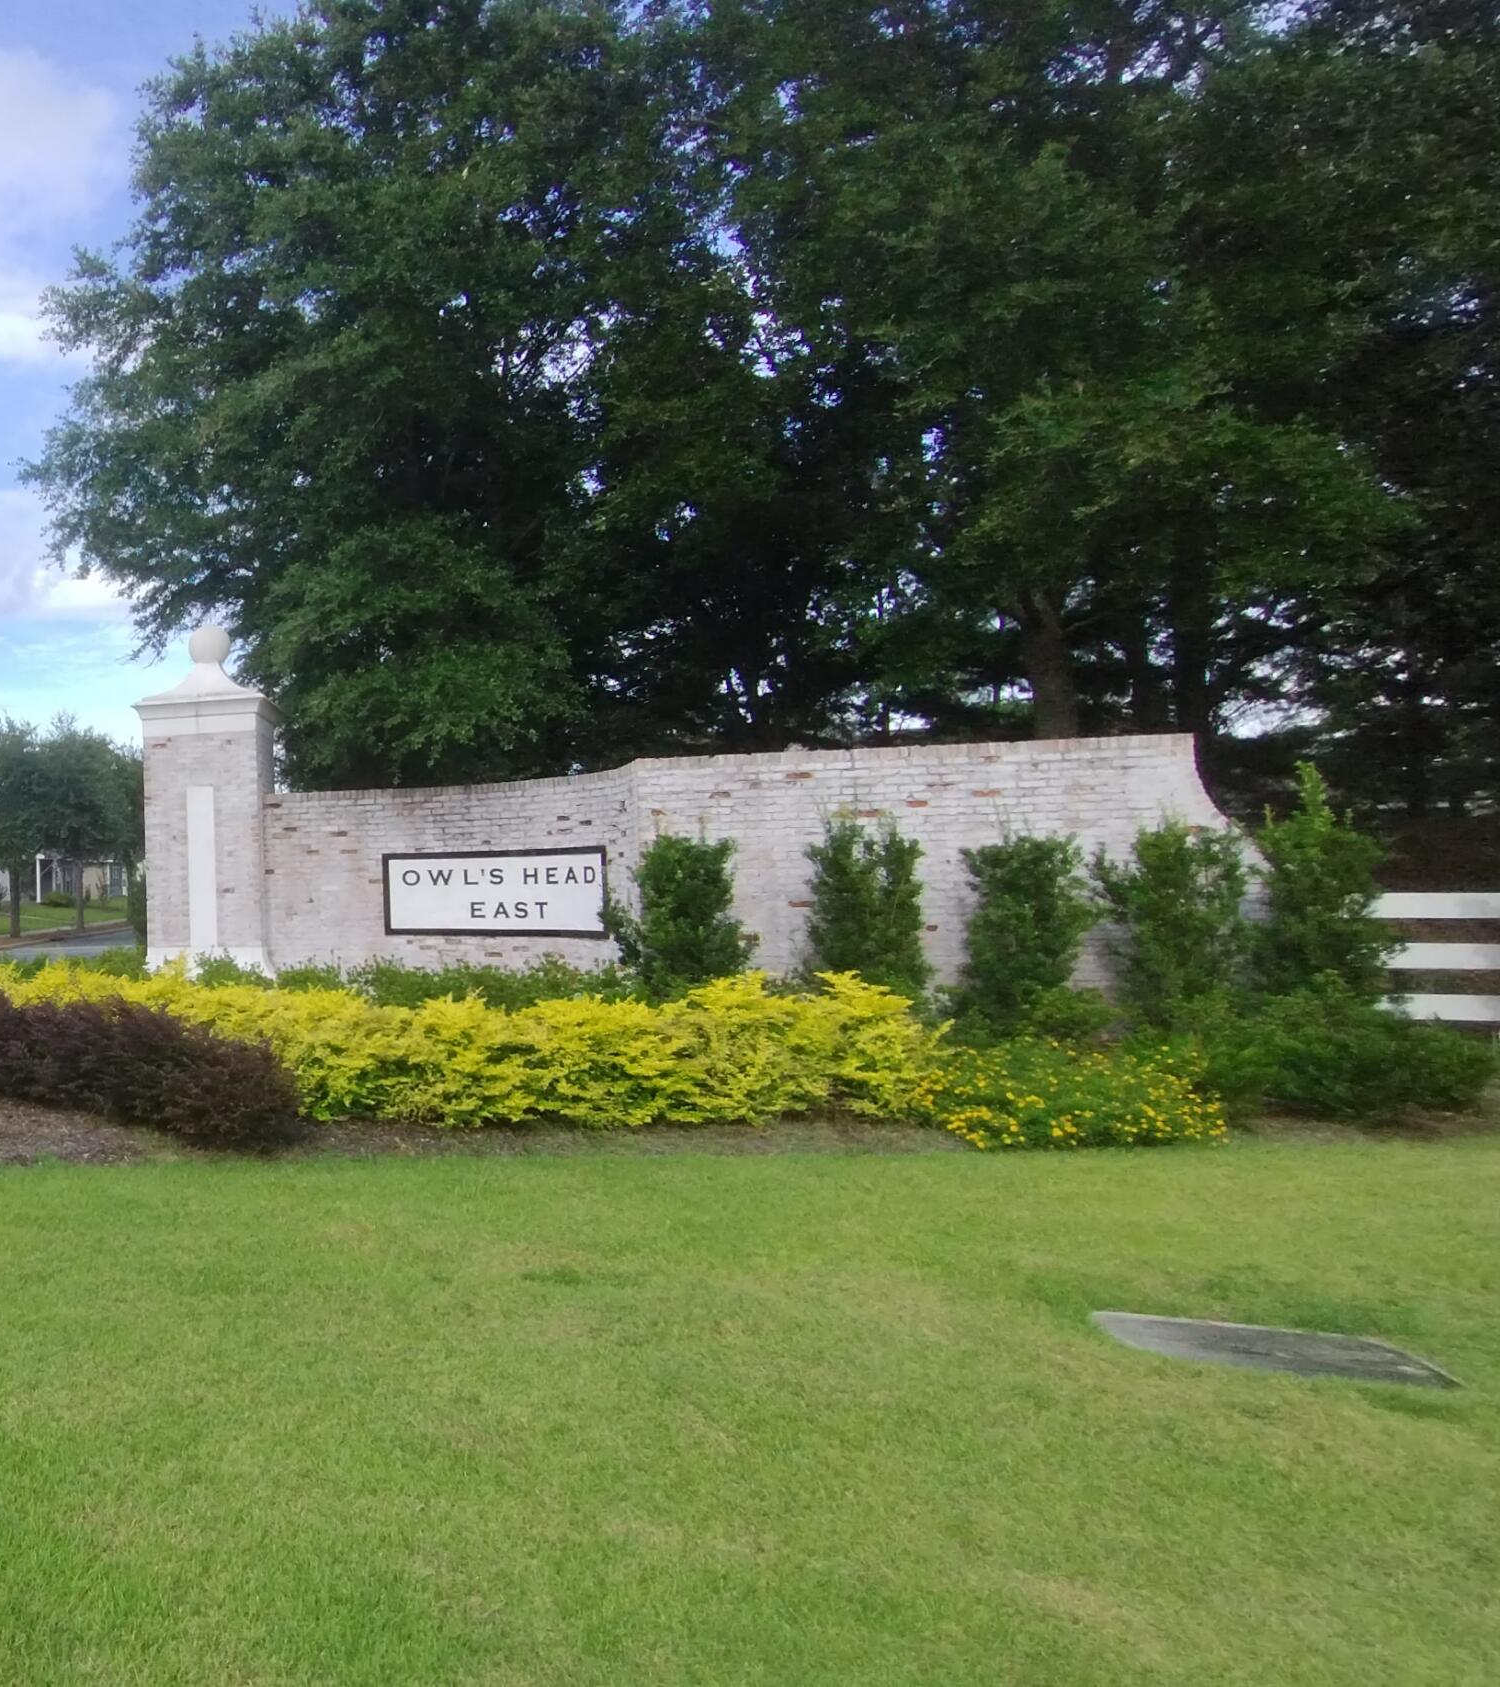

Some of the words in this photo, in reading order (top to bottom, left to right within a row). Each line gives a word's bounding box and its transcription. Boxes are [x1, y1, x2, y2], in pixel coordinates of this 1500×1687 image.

[401, 868, 505, 886] OWL'S
[522, 866, 596, 885] HEAD
[469, 901, 549, 919] EAST
